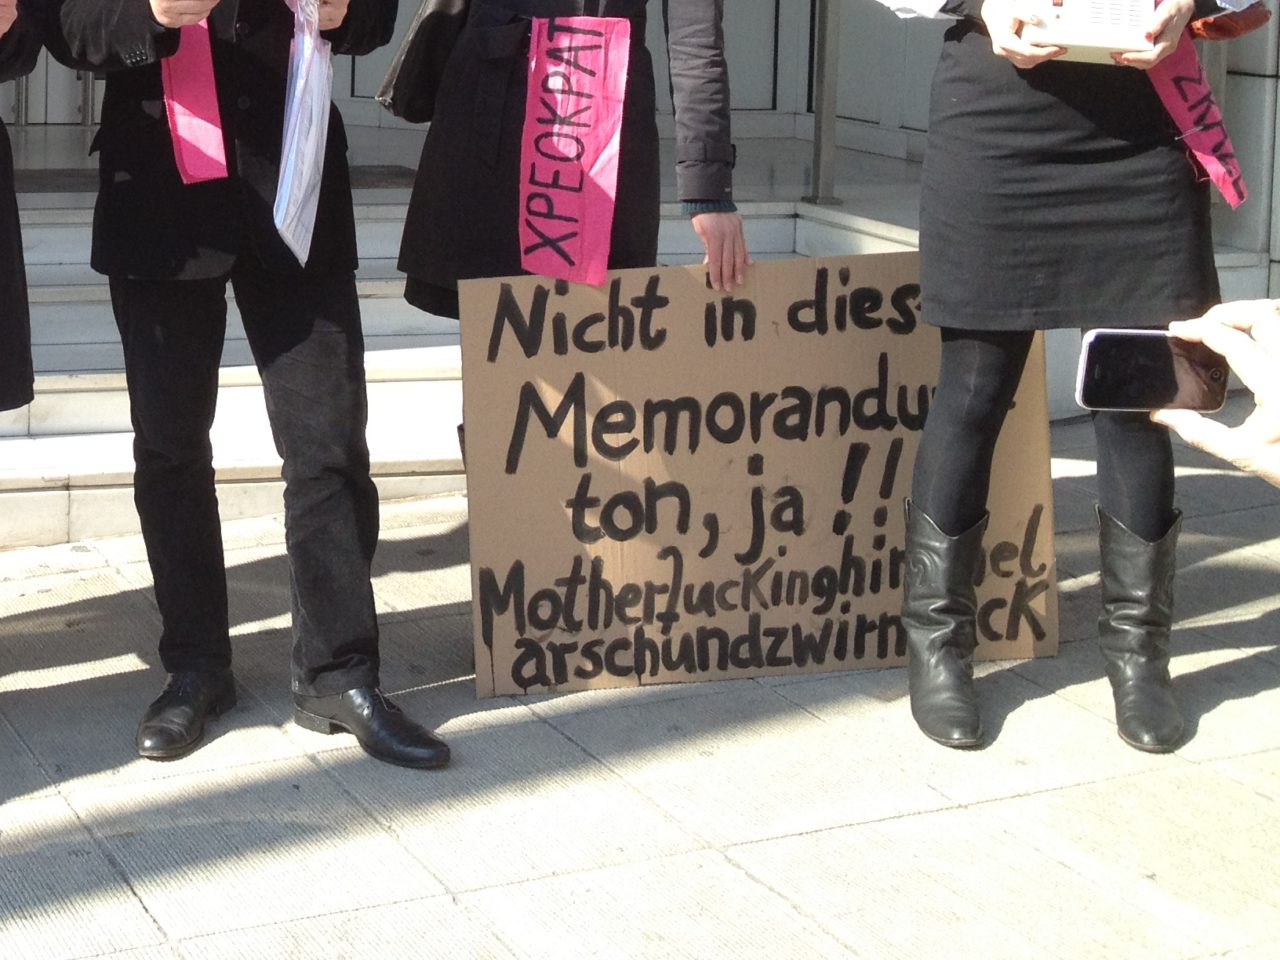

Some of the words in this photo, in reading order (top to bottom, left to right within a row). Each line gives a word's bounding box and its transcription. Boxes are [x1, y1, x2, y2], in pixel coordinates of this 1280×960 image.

[487, 275, 669, 363] Nicht
[704, 271, 756, 348] in
[787, 266, 922, 335] dies
[505, 352, 937, 475] Memorandu
[565, 472, 719, 558] ton,
